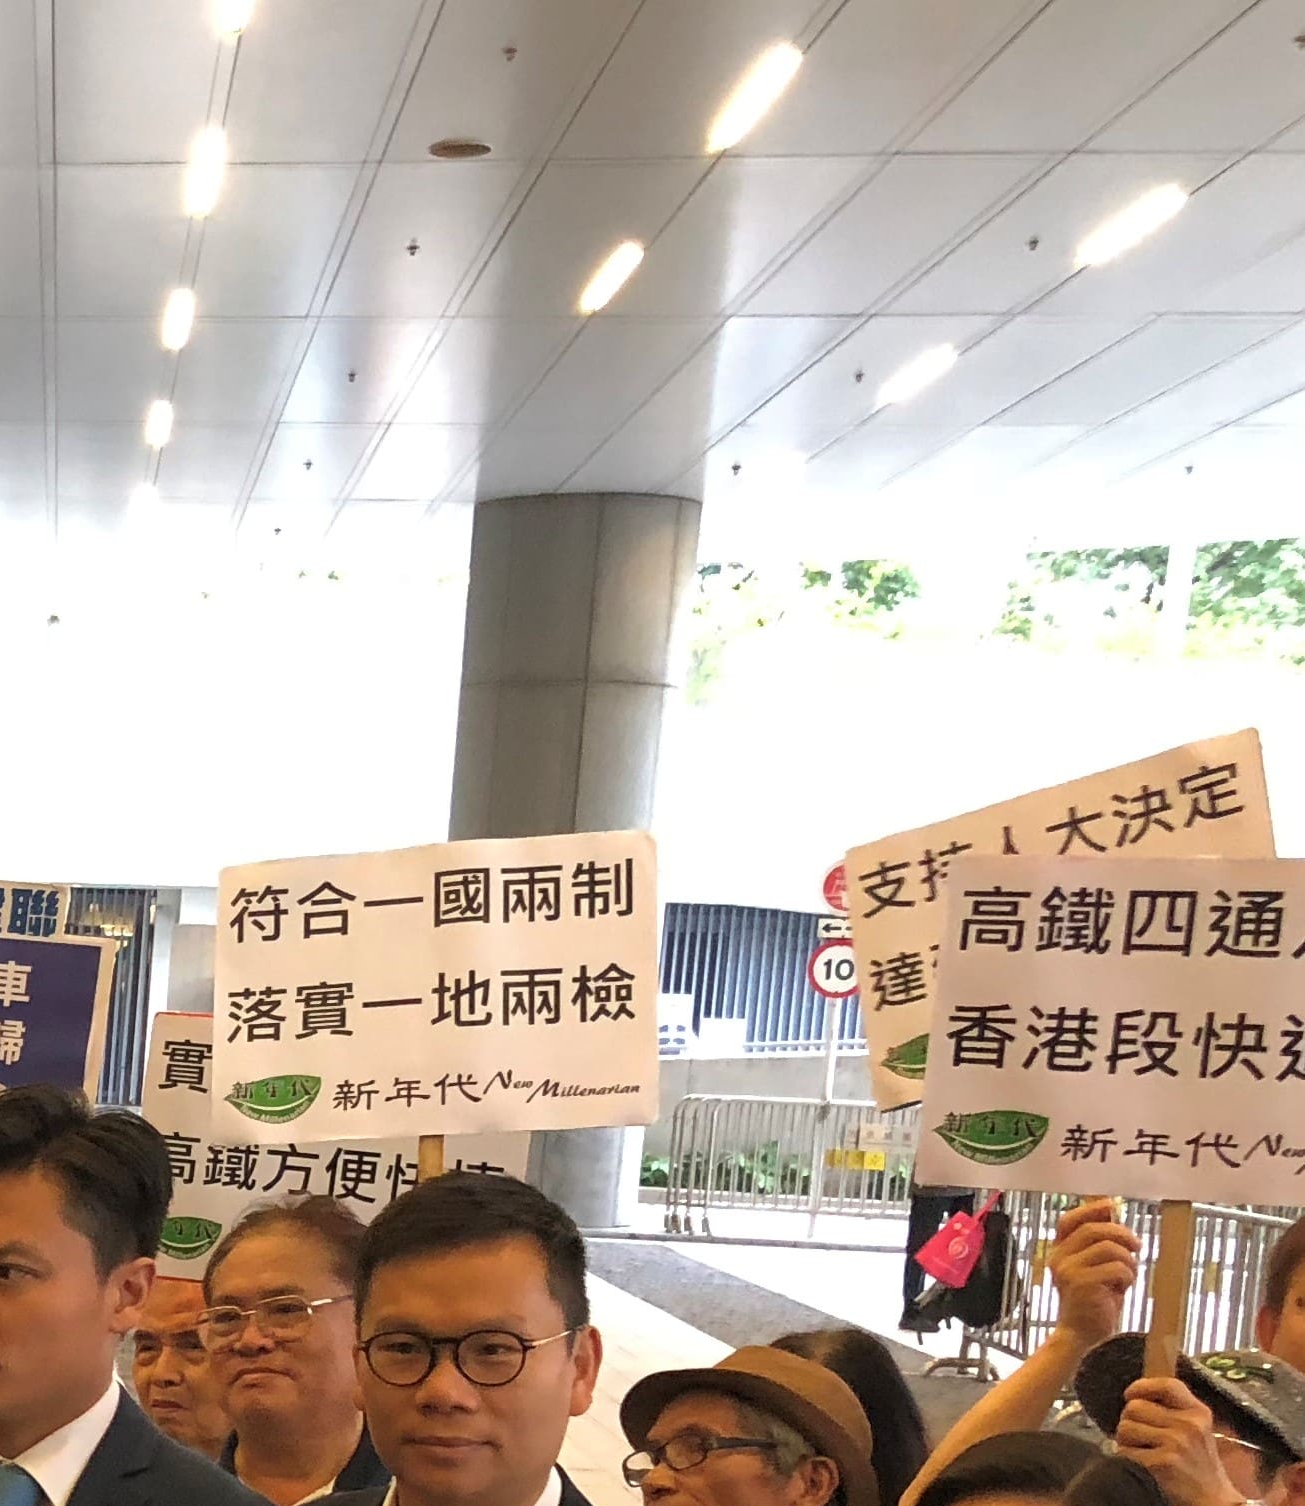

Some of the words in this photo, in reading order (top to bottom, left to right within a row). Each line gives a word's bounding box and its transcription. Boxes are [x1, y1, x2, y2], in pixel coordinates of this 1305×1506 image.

[229, 858, 635, 943] 符合一國兩制
[960, 886, 1305, 959] 高鐵四通
[226, 962, 636, 1044] 落實一地兩檢
[823, 958, 855, 981] 10
[870, 944, 940, 1011] 達
[158, 1039, 213, 1094] 實
[332, 1073, 483, 1112] 新年代
[483, 1069, 533, 1095] New
[526, 1079, 641, 1104] Millenarian
[163, 1132, 504, 1203] 高鐵方便
[1061, 1124, 1240, 1168] 新年代
